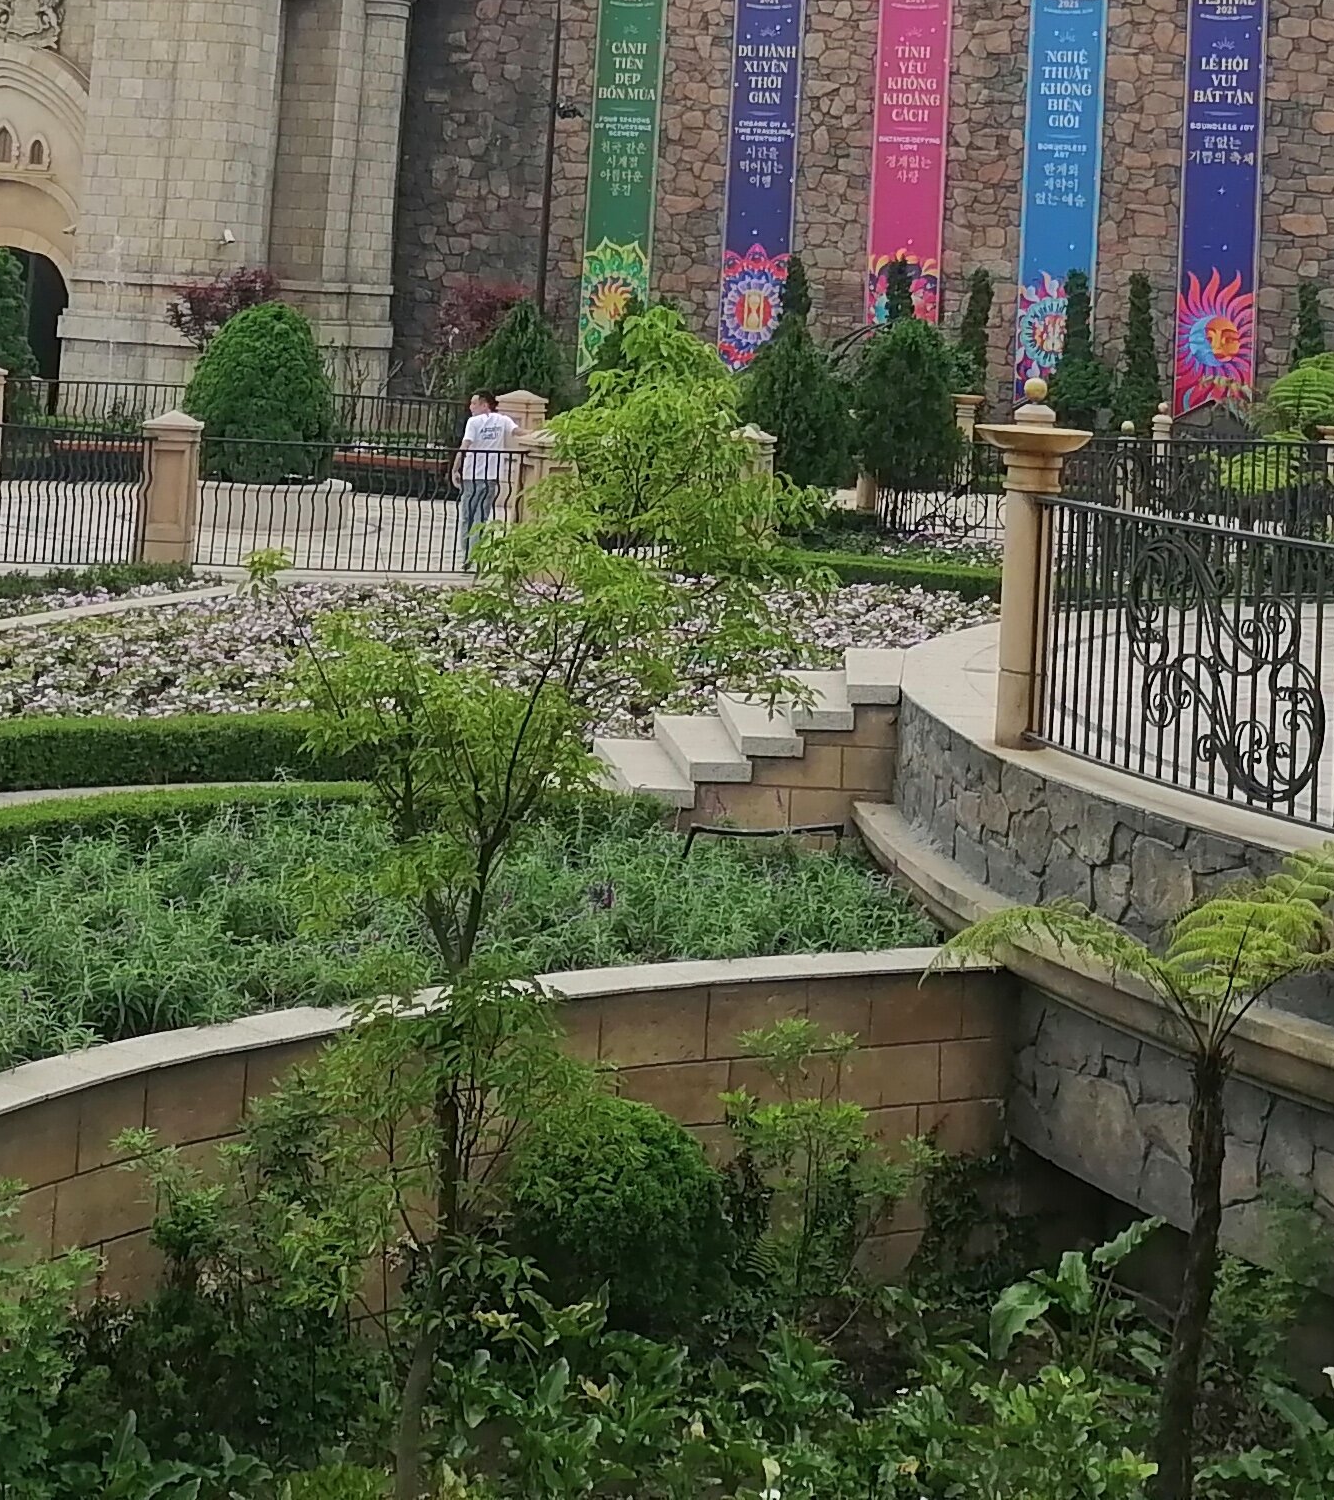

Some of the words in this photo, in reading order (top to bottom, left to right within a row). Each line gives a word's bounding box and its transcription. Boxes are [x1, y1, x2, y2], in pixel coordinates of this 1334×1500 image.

[738, 45, 756, 57] DU
[888, 75, 937, 90] KHÔNG
[1212, 74, 1237, 87] VUI
[1040, 82, 1092, 96] KHÔNG
[748, 92, 781, 104] GIAN
[1224, 89, 1254, 106] TẬN
